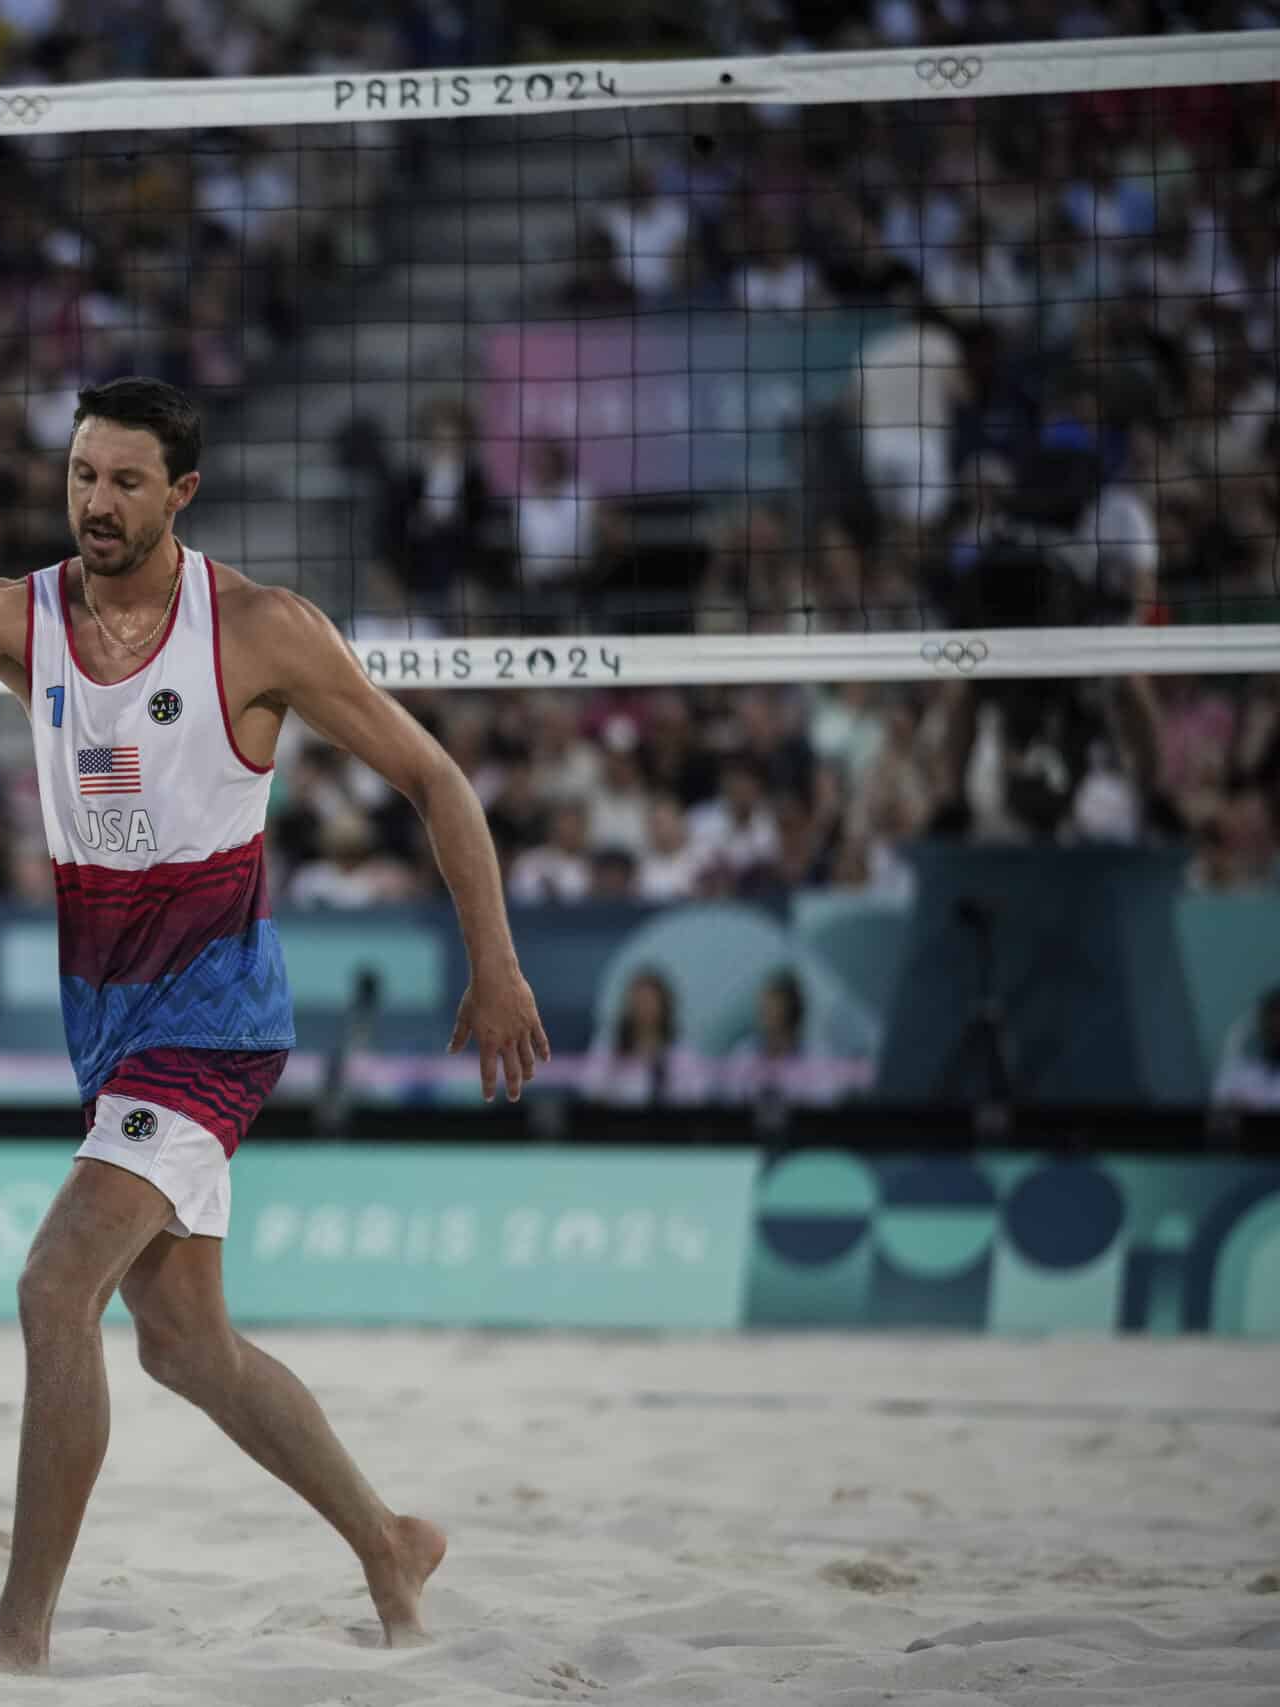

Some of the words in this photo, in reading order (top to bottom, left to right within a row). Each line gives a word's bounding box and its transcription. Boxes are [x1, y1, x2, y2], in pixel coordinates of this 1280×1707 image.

[493, 70, 616, 106] 2024
[365, 647, 472, 679] ARIS
[494, 646, 621, 679] 2024
[72, 808, 158, 853] USA
